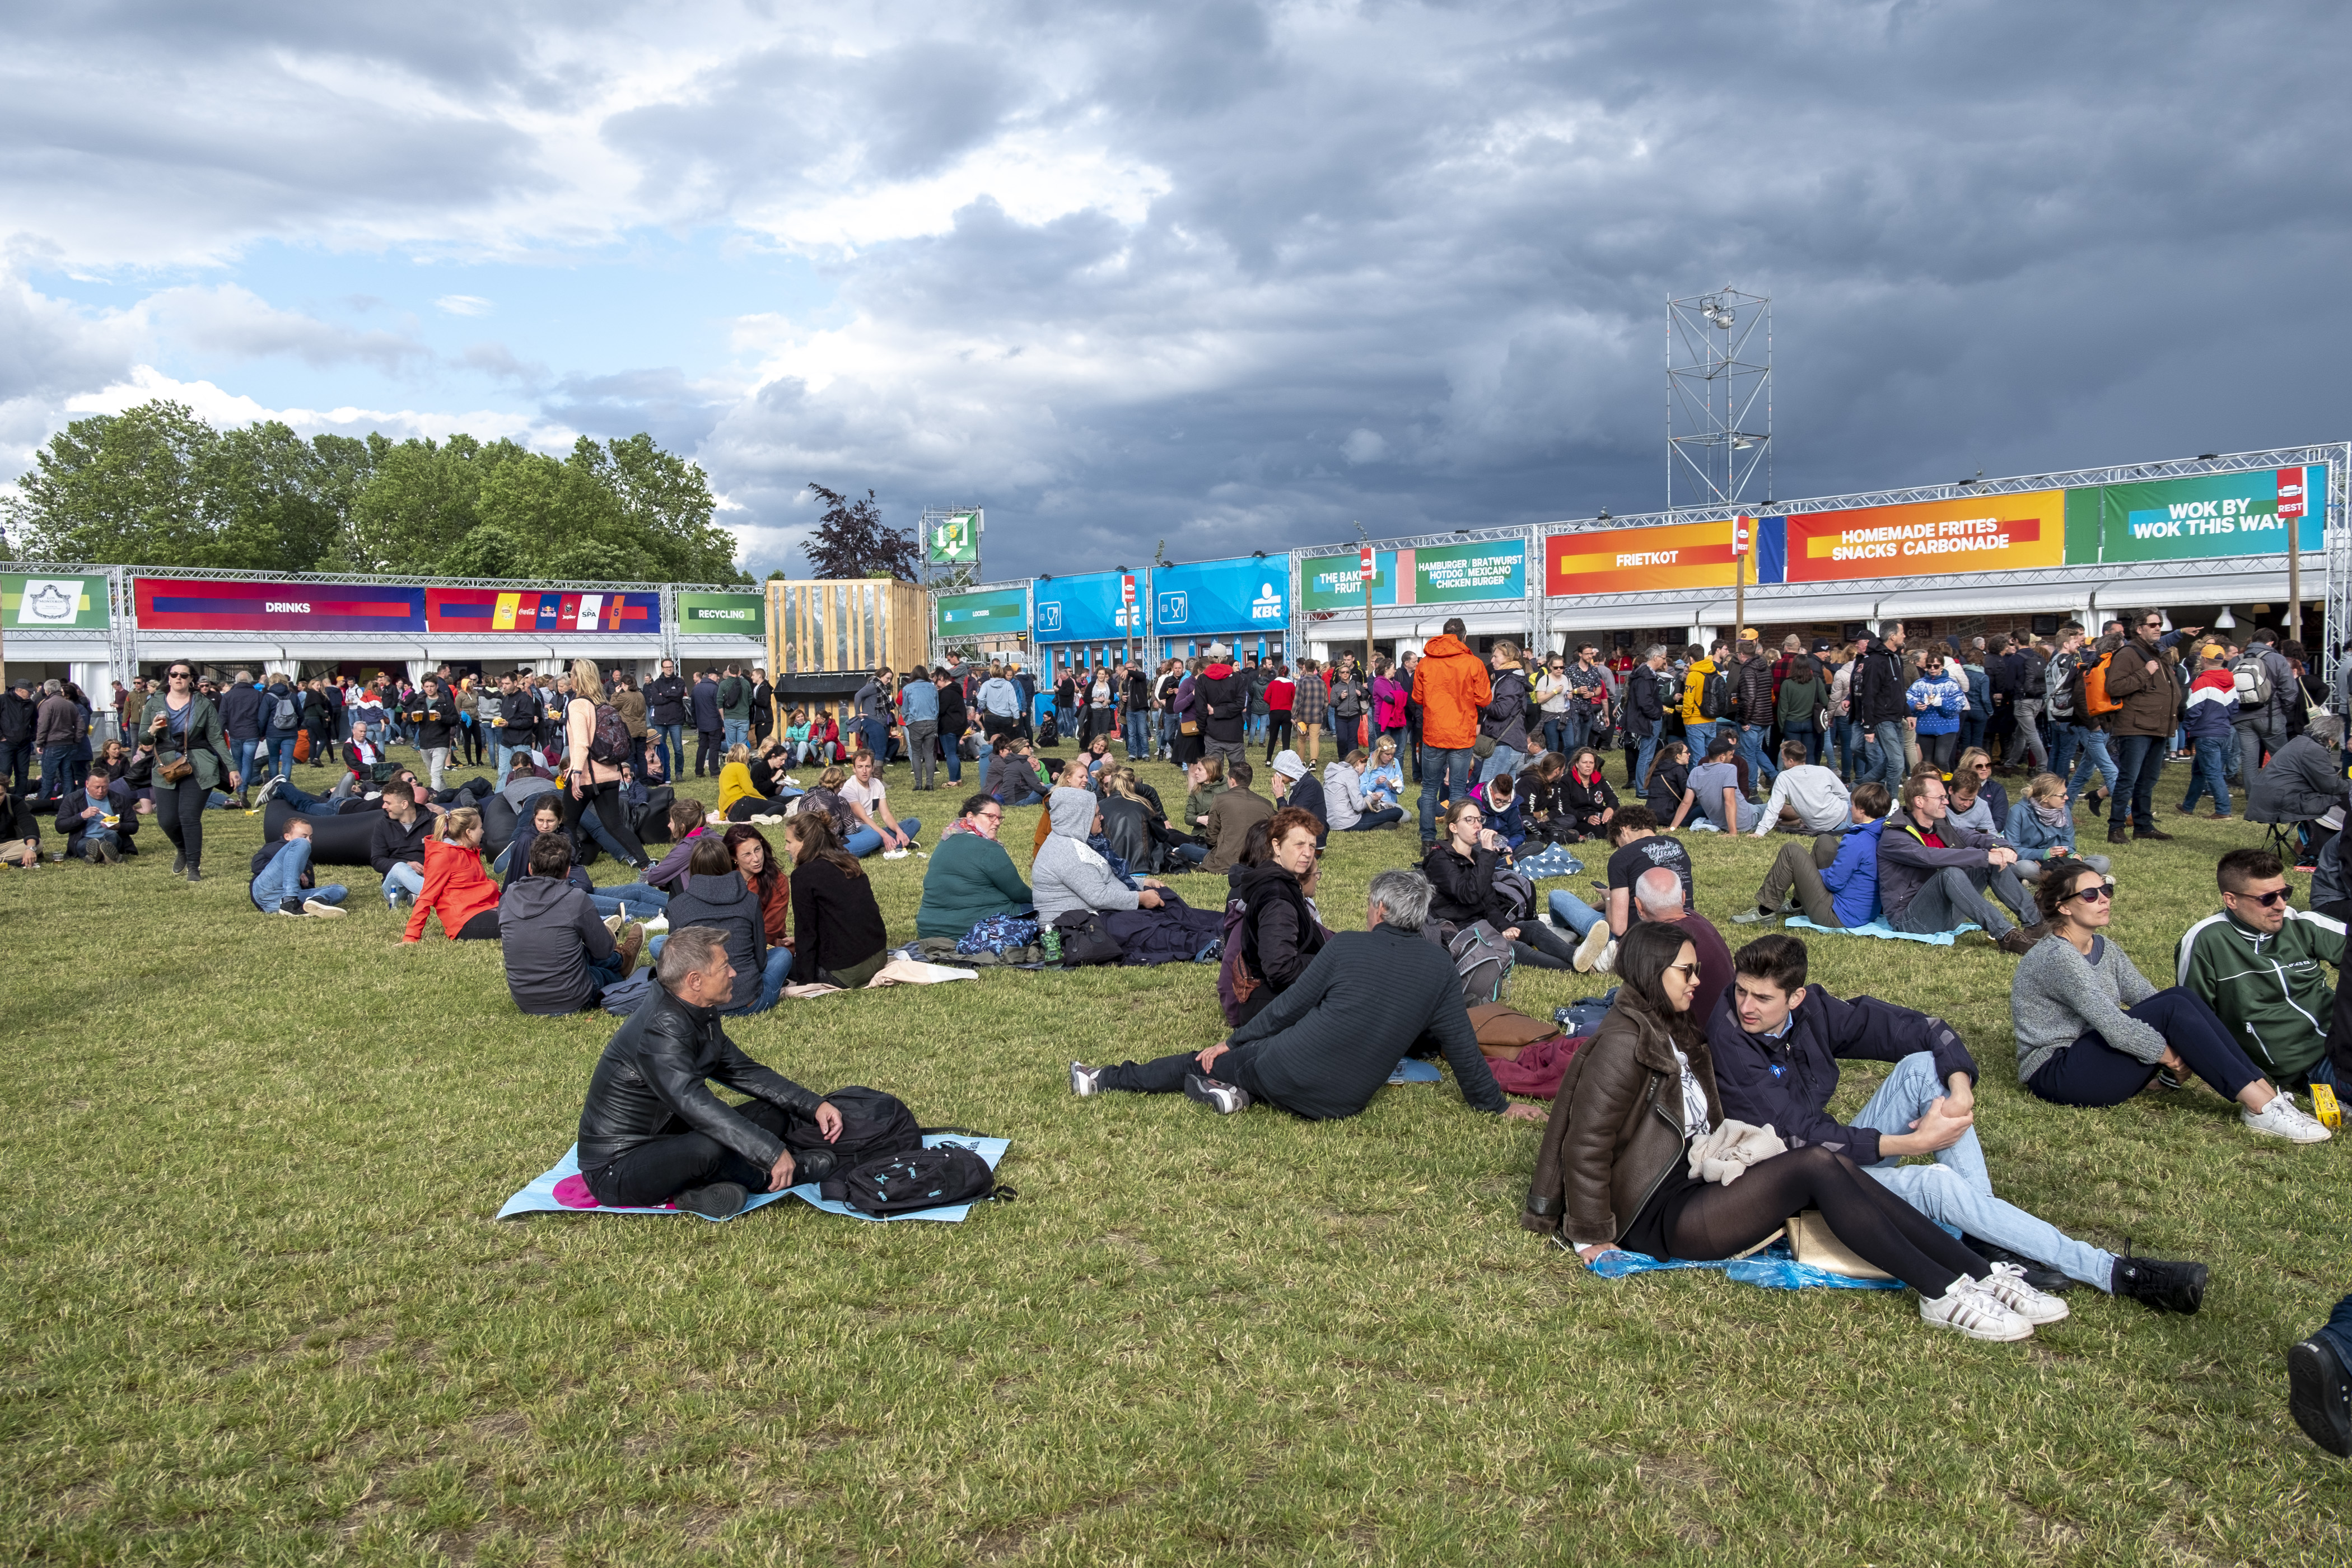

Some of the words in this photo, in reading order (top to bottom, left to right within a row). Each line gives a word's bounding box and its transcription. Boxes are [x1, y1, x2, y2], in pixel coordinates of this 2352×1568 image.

[2169, 500, 2218, 519] WOK
[2223, 498, 2251, 516] BY
[2278, 503, 2303, 512] REST
[949, 525, 957, 538] 5
[1841, 523, 1935, 544] HOMEMADE
[1939, 518, 1998, 536] FRITES
[2134, 521, 2182, 539] WOK
[2186, 517, 2235, 535] THIS
[2239, 513, 2288, 531] WAY
[1832, 543, 1897, 561] SNACKS
[1903, 534, 2009, 556] CARBONADE
[1418, 559, 1467, 571] HAMBURGER
[1472, 555, 1523, 567] BRATWURST
[1617, 550, 1678, 567] FRIETKOT
[1319, 572, 1338, 584] THE
[1430, 569, 1463, 580] HOTDOG
[1468, 566, 1511, 577] MEXICANO
[1335, 581, 1361, 594] FRUIT
[1436, 579, 1471, 589] CHICKEN
[1472, 576, 1504, 586] BURGER
[266, 602, 310, 613] DRINKS
[614, 608, 619, 617] 5
[698, 610, 745, 618] RECYCLING
[1253, 605, 1281, 618] KBC
[1813, 624, 1837, 633] WELCOME
[1958, 627, 1972, 638] GOOD
[1973, 622, 1987, 633] FOOD
